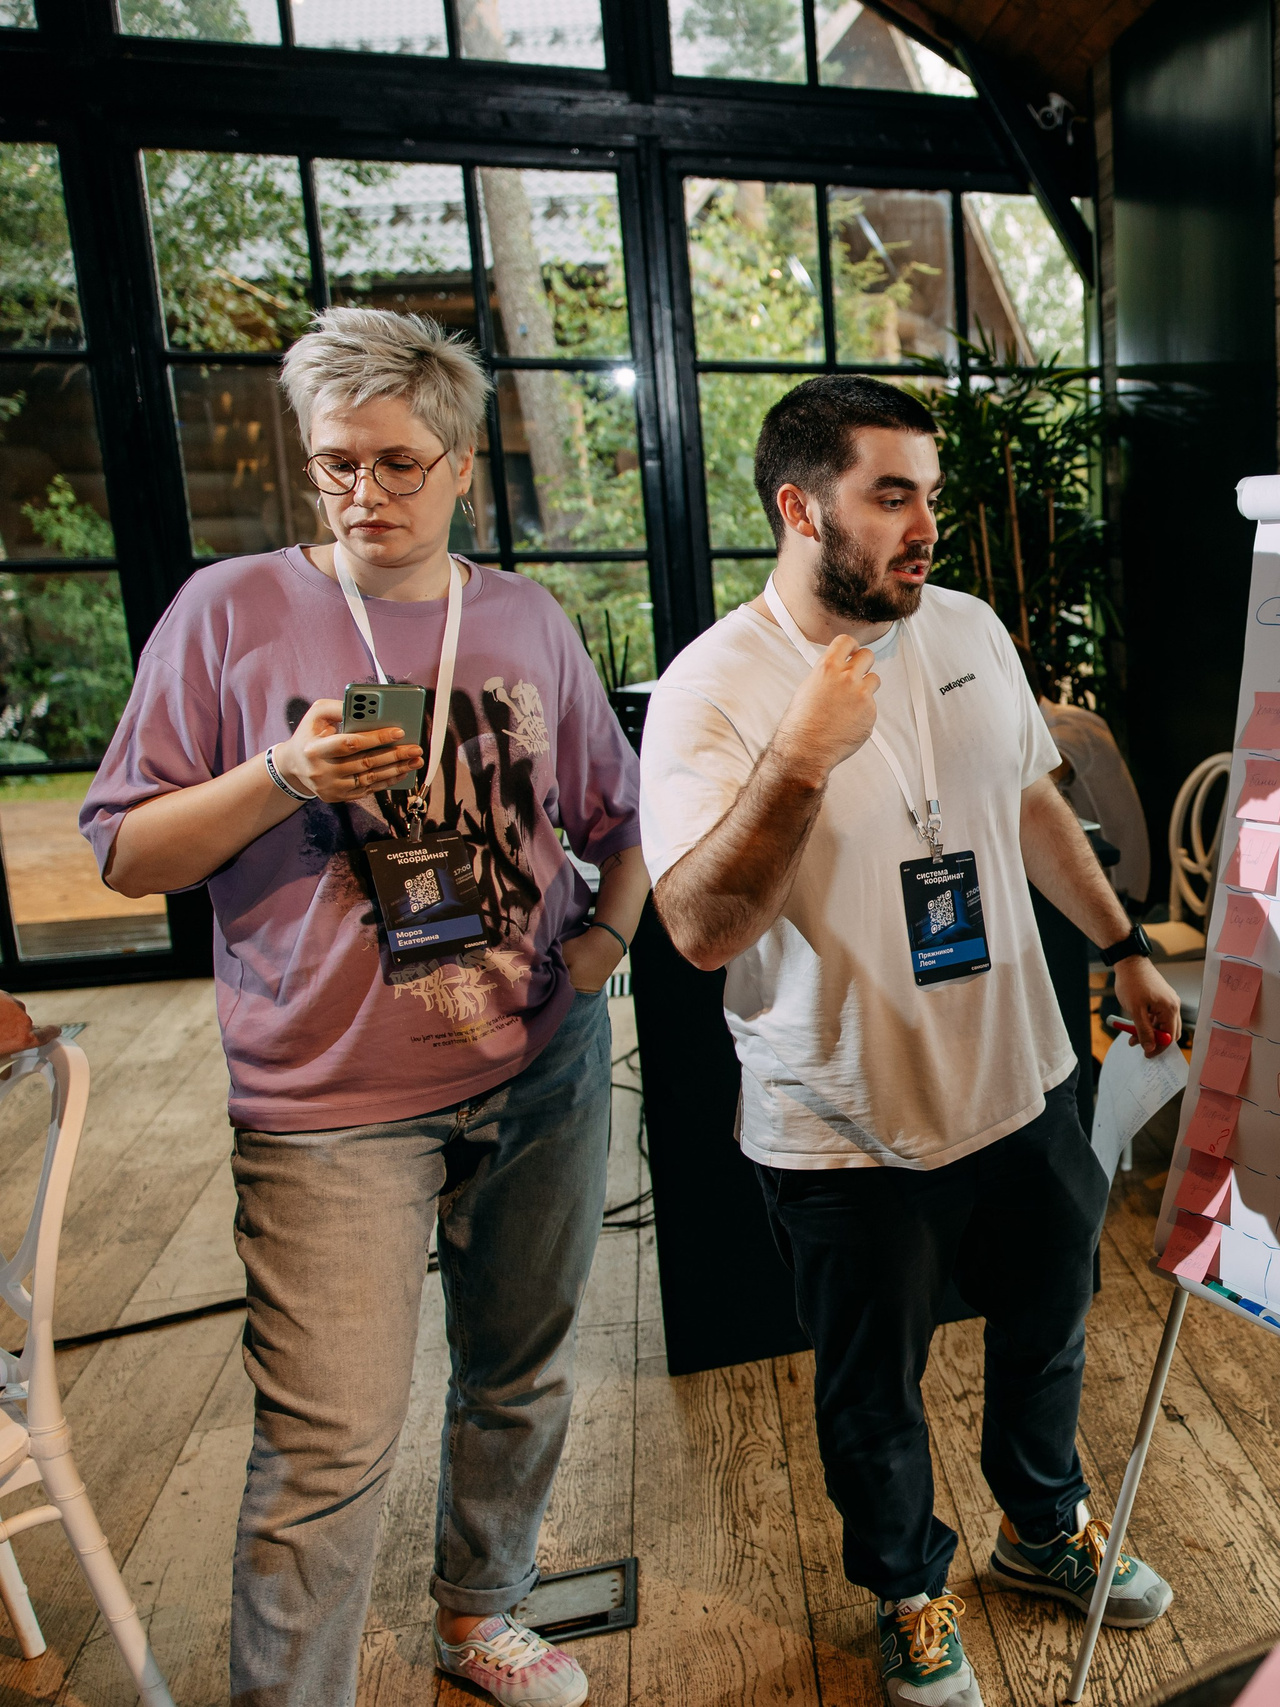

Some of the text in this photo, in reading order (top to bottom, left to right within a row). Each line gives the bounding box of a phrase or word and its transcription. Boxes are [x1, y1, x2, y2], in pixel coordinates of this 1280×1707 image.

[939, 673, 976, 695] patagonia
[387, 848, 428, 860] система
[398, 851, 449, 865] координат
[916, 868, 949, 881] система
[924, 871, 965, 885] координат
[396, 928, 423, 939] Мороз
[397, 934, 440, 947] Екатерина
[917, 947, 954, 960] Пряжников
[919, 959, 937, 968] Леон
